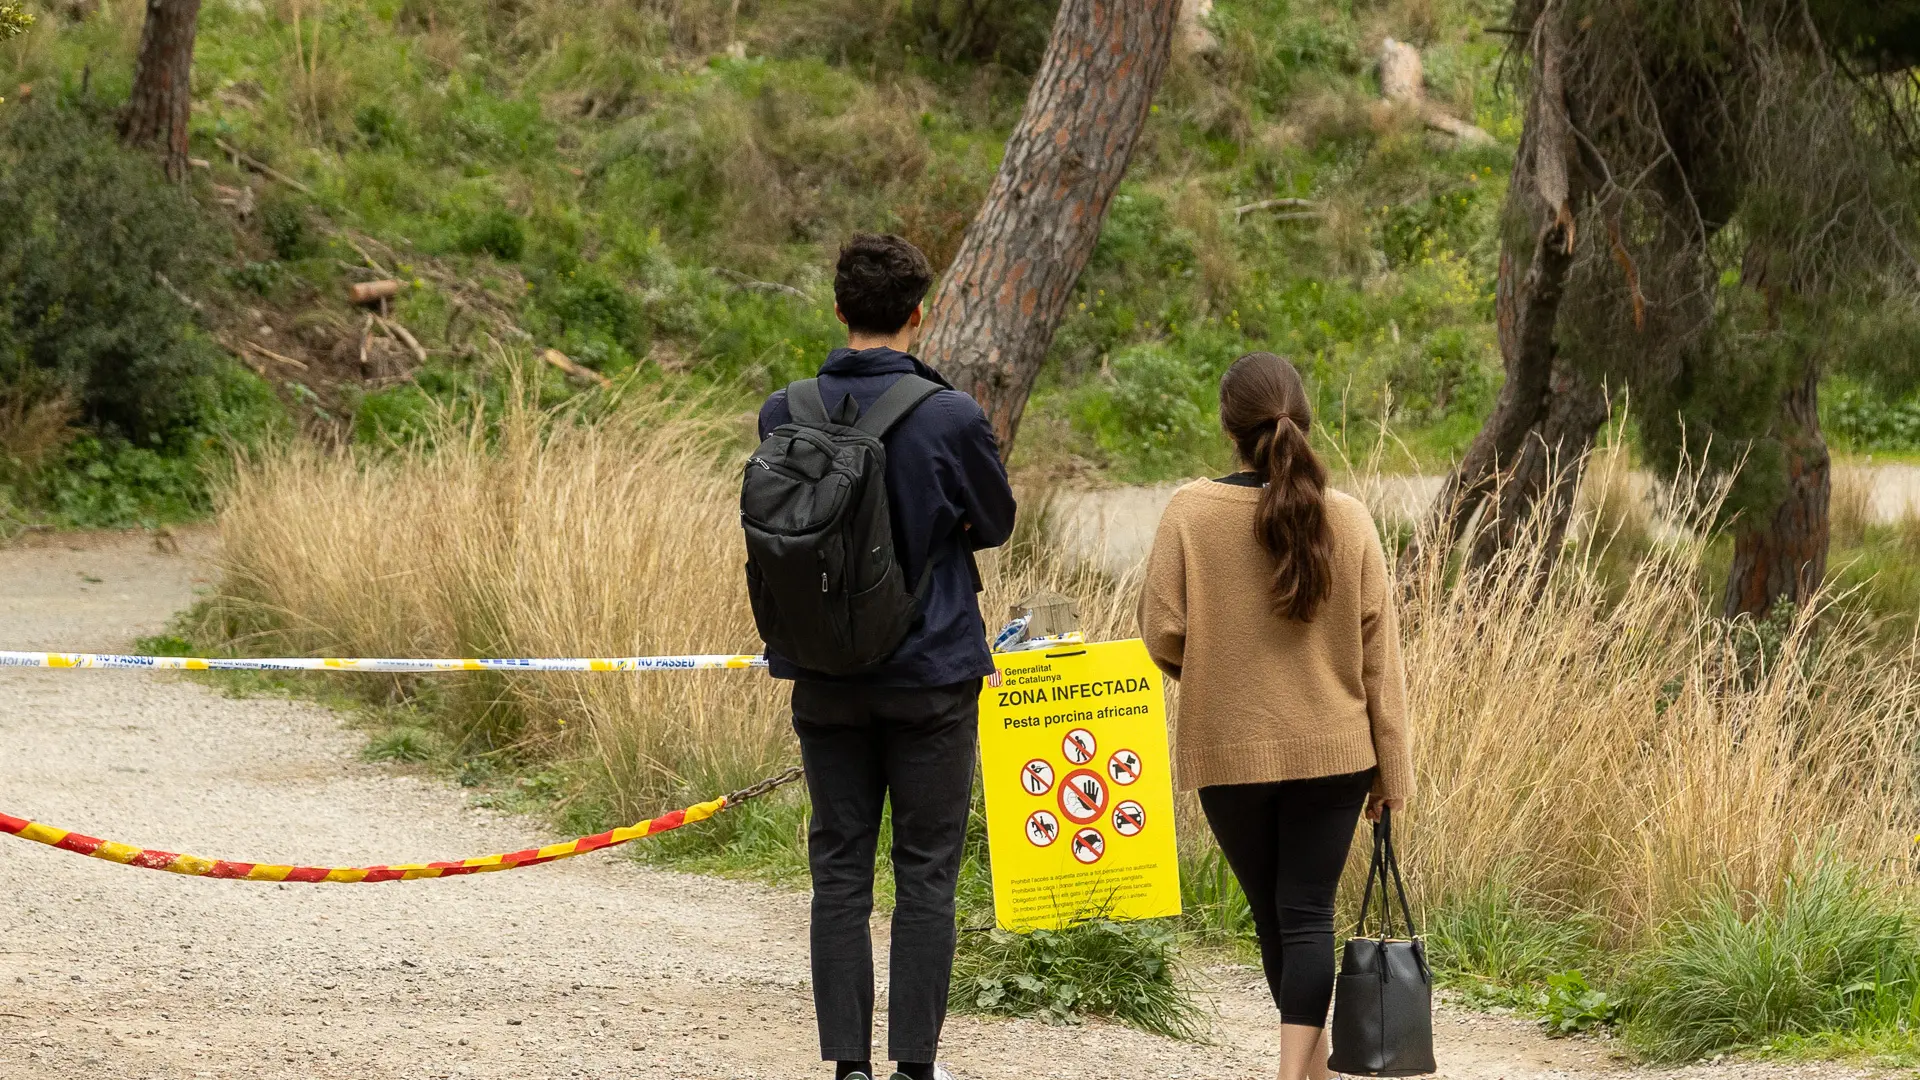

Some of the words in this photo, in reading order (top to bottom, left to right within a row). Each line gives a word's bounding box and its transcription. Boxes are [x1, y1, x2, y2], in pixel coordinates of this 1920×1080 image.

[1004, 664, 1052, 676] Generalitat
[1005, 678, 1016, 686] de
[1018, 674, 1062, 685] Catalunya
[998, 688, 1048, 707] ZONA
[1052, 677, 1150, 701] INFECTADA
[1004, 715, 1040, 729] Pesta
[1044, 710, 1093, 728] porcina
[1097, 705, 1149, 719] africana
